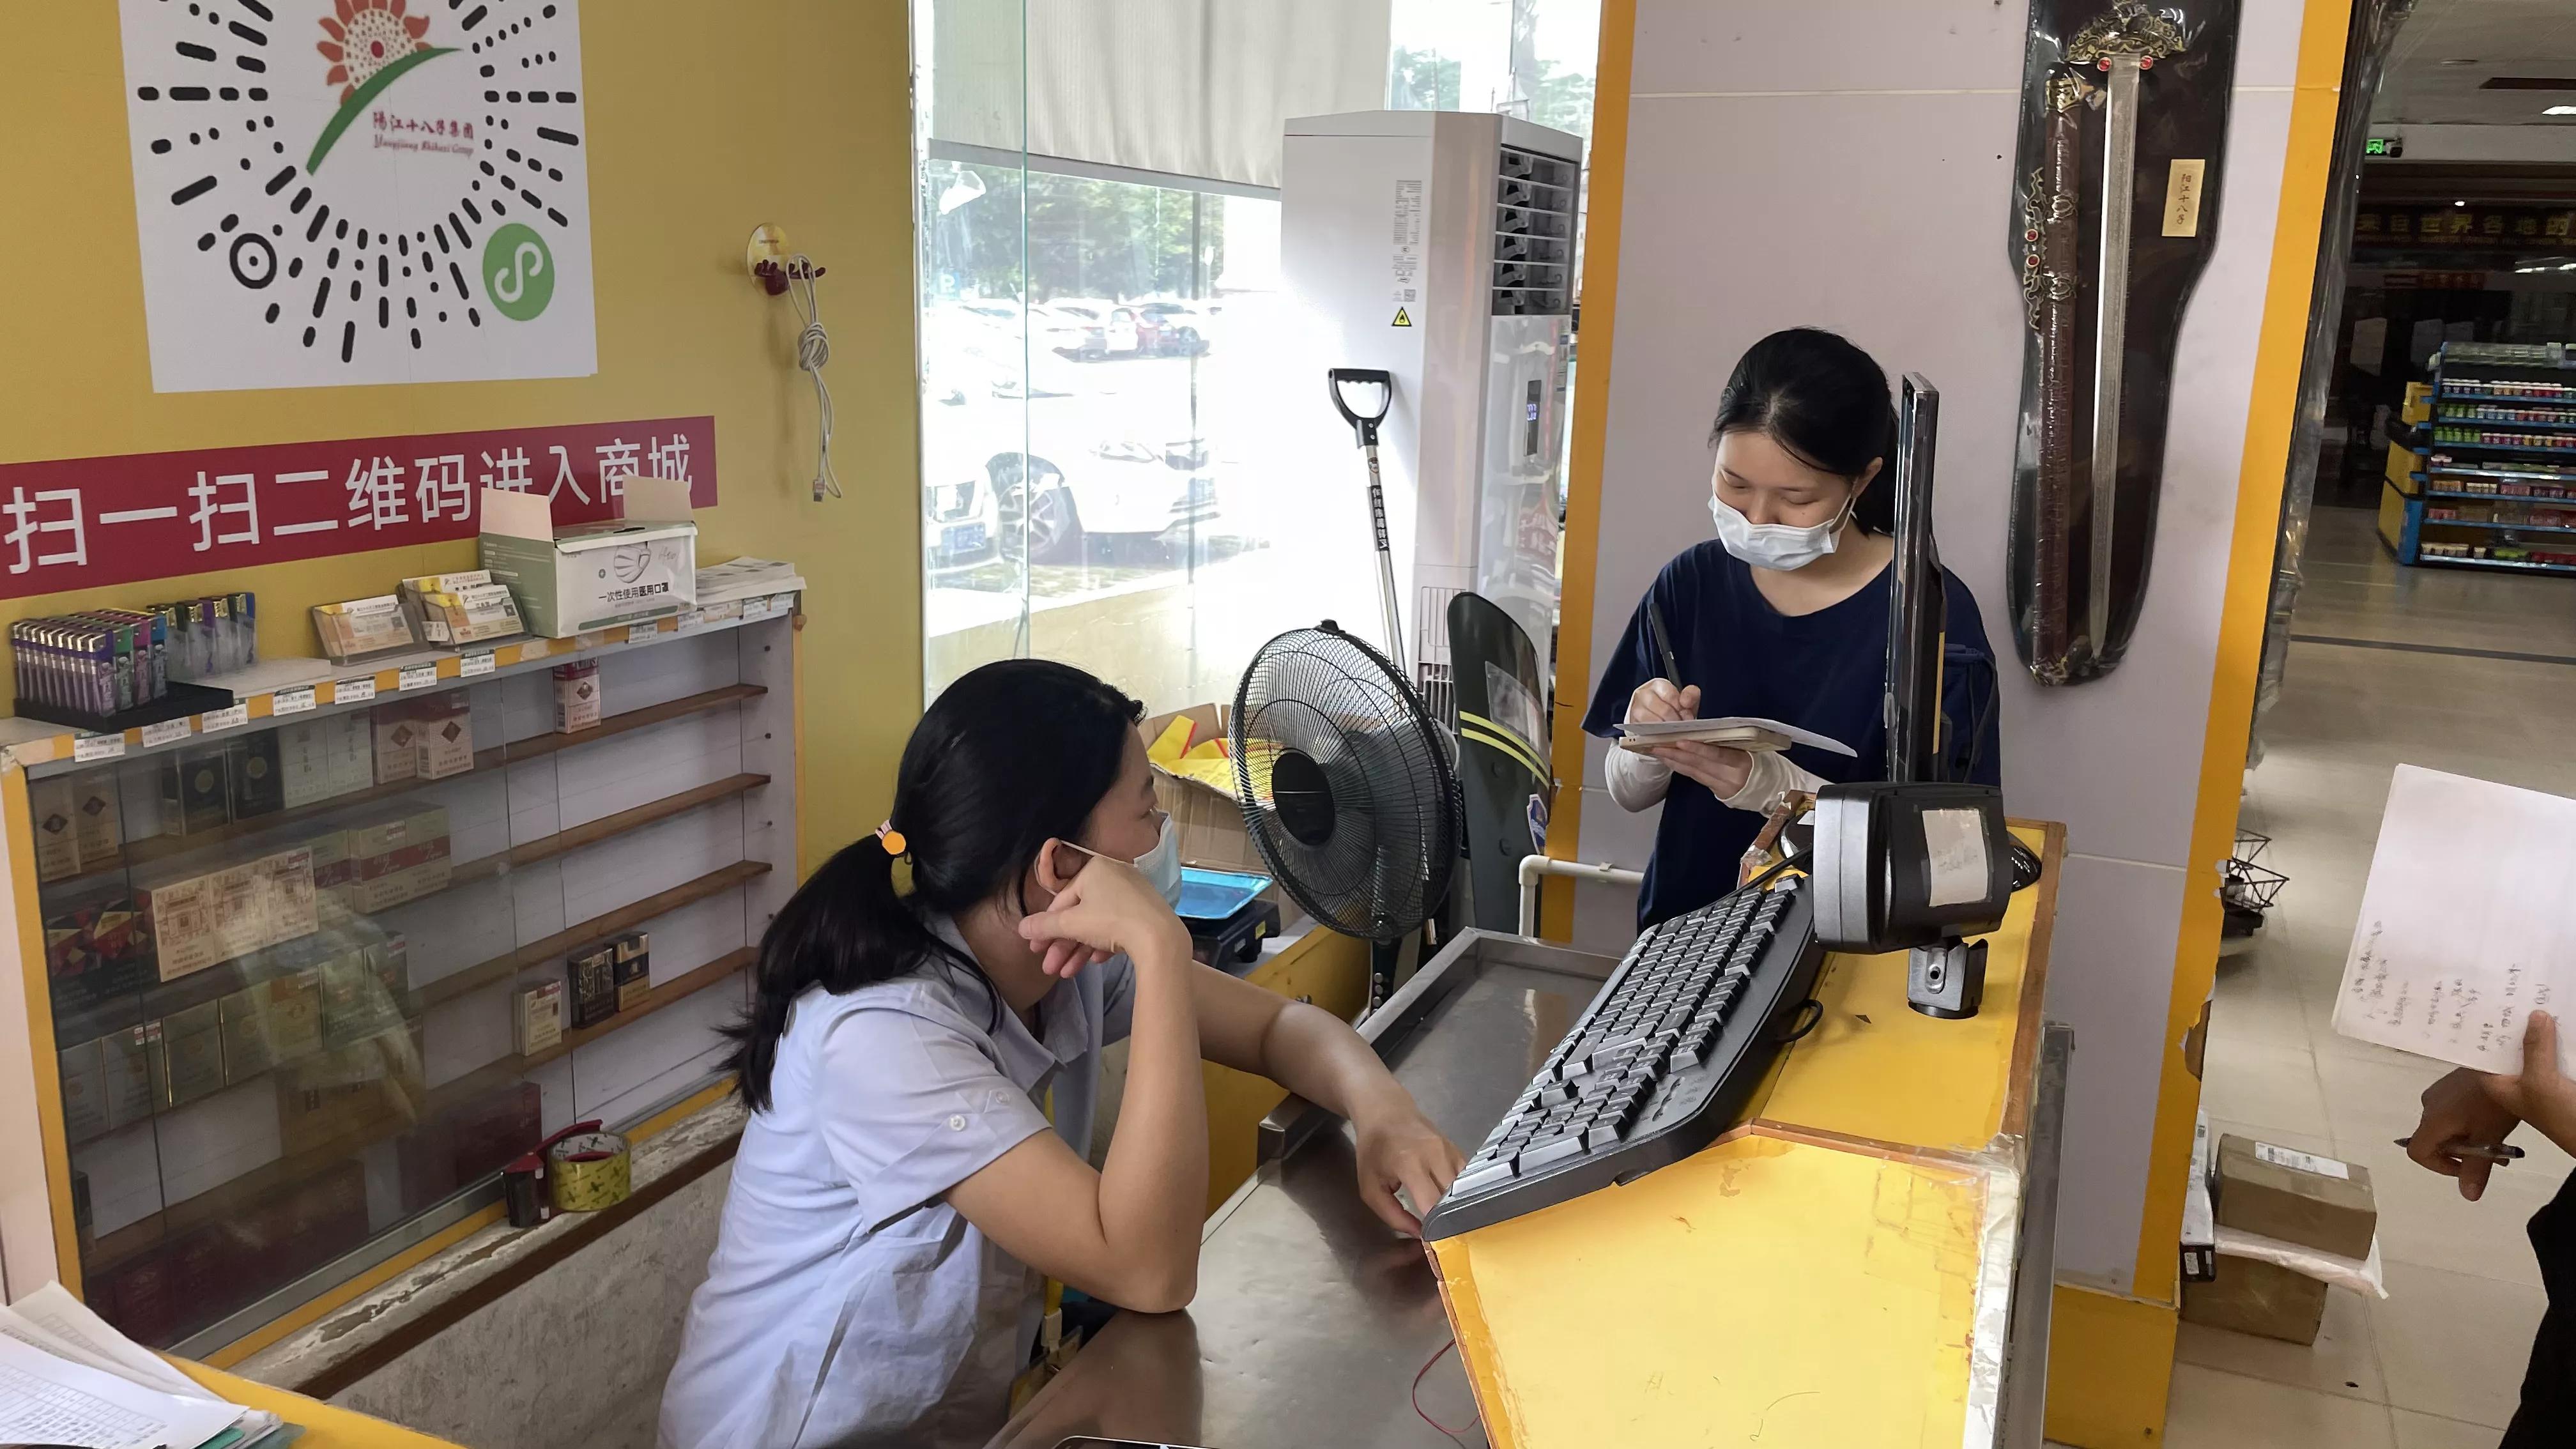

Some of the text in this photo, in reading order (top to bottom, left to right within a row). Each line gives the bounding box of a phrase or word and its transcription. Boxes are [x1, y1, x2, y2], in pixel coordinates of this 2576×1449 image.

[940, 274, 955, 293] P
[599, 582, 668, 602] 一次性使用医用口罩
